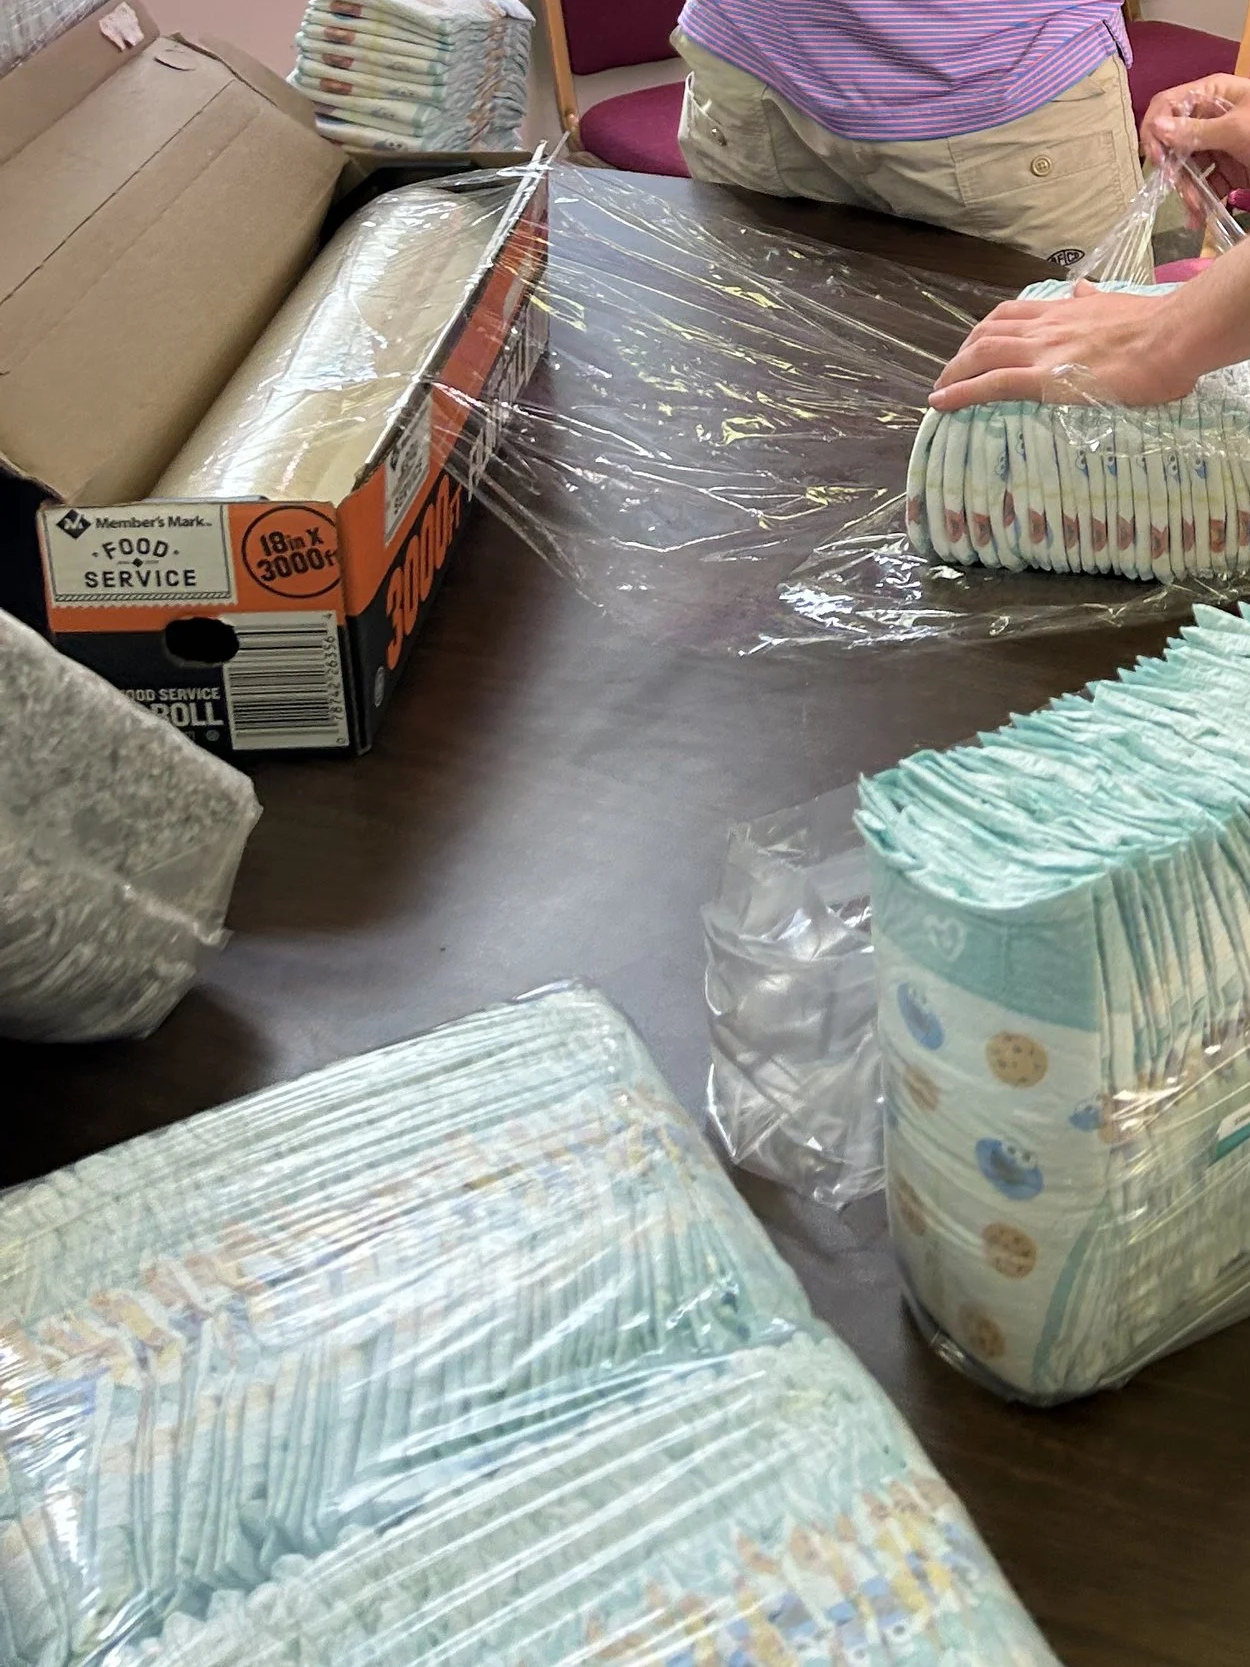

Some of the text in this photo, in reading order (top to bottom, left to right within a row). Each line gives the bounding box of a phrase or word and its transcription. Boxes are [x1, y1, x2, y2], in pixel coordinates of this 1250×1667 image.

[95, 517, 166, 529] Member's
[102, 538, 169, 560] FOOD
[85, 569, 197, 588] SERVICE
[158, 687, 221, 702] SERVICE
